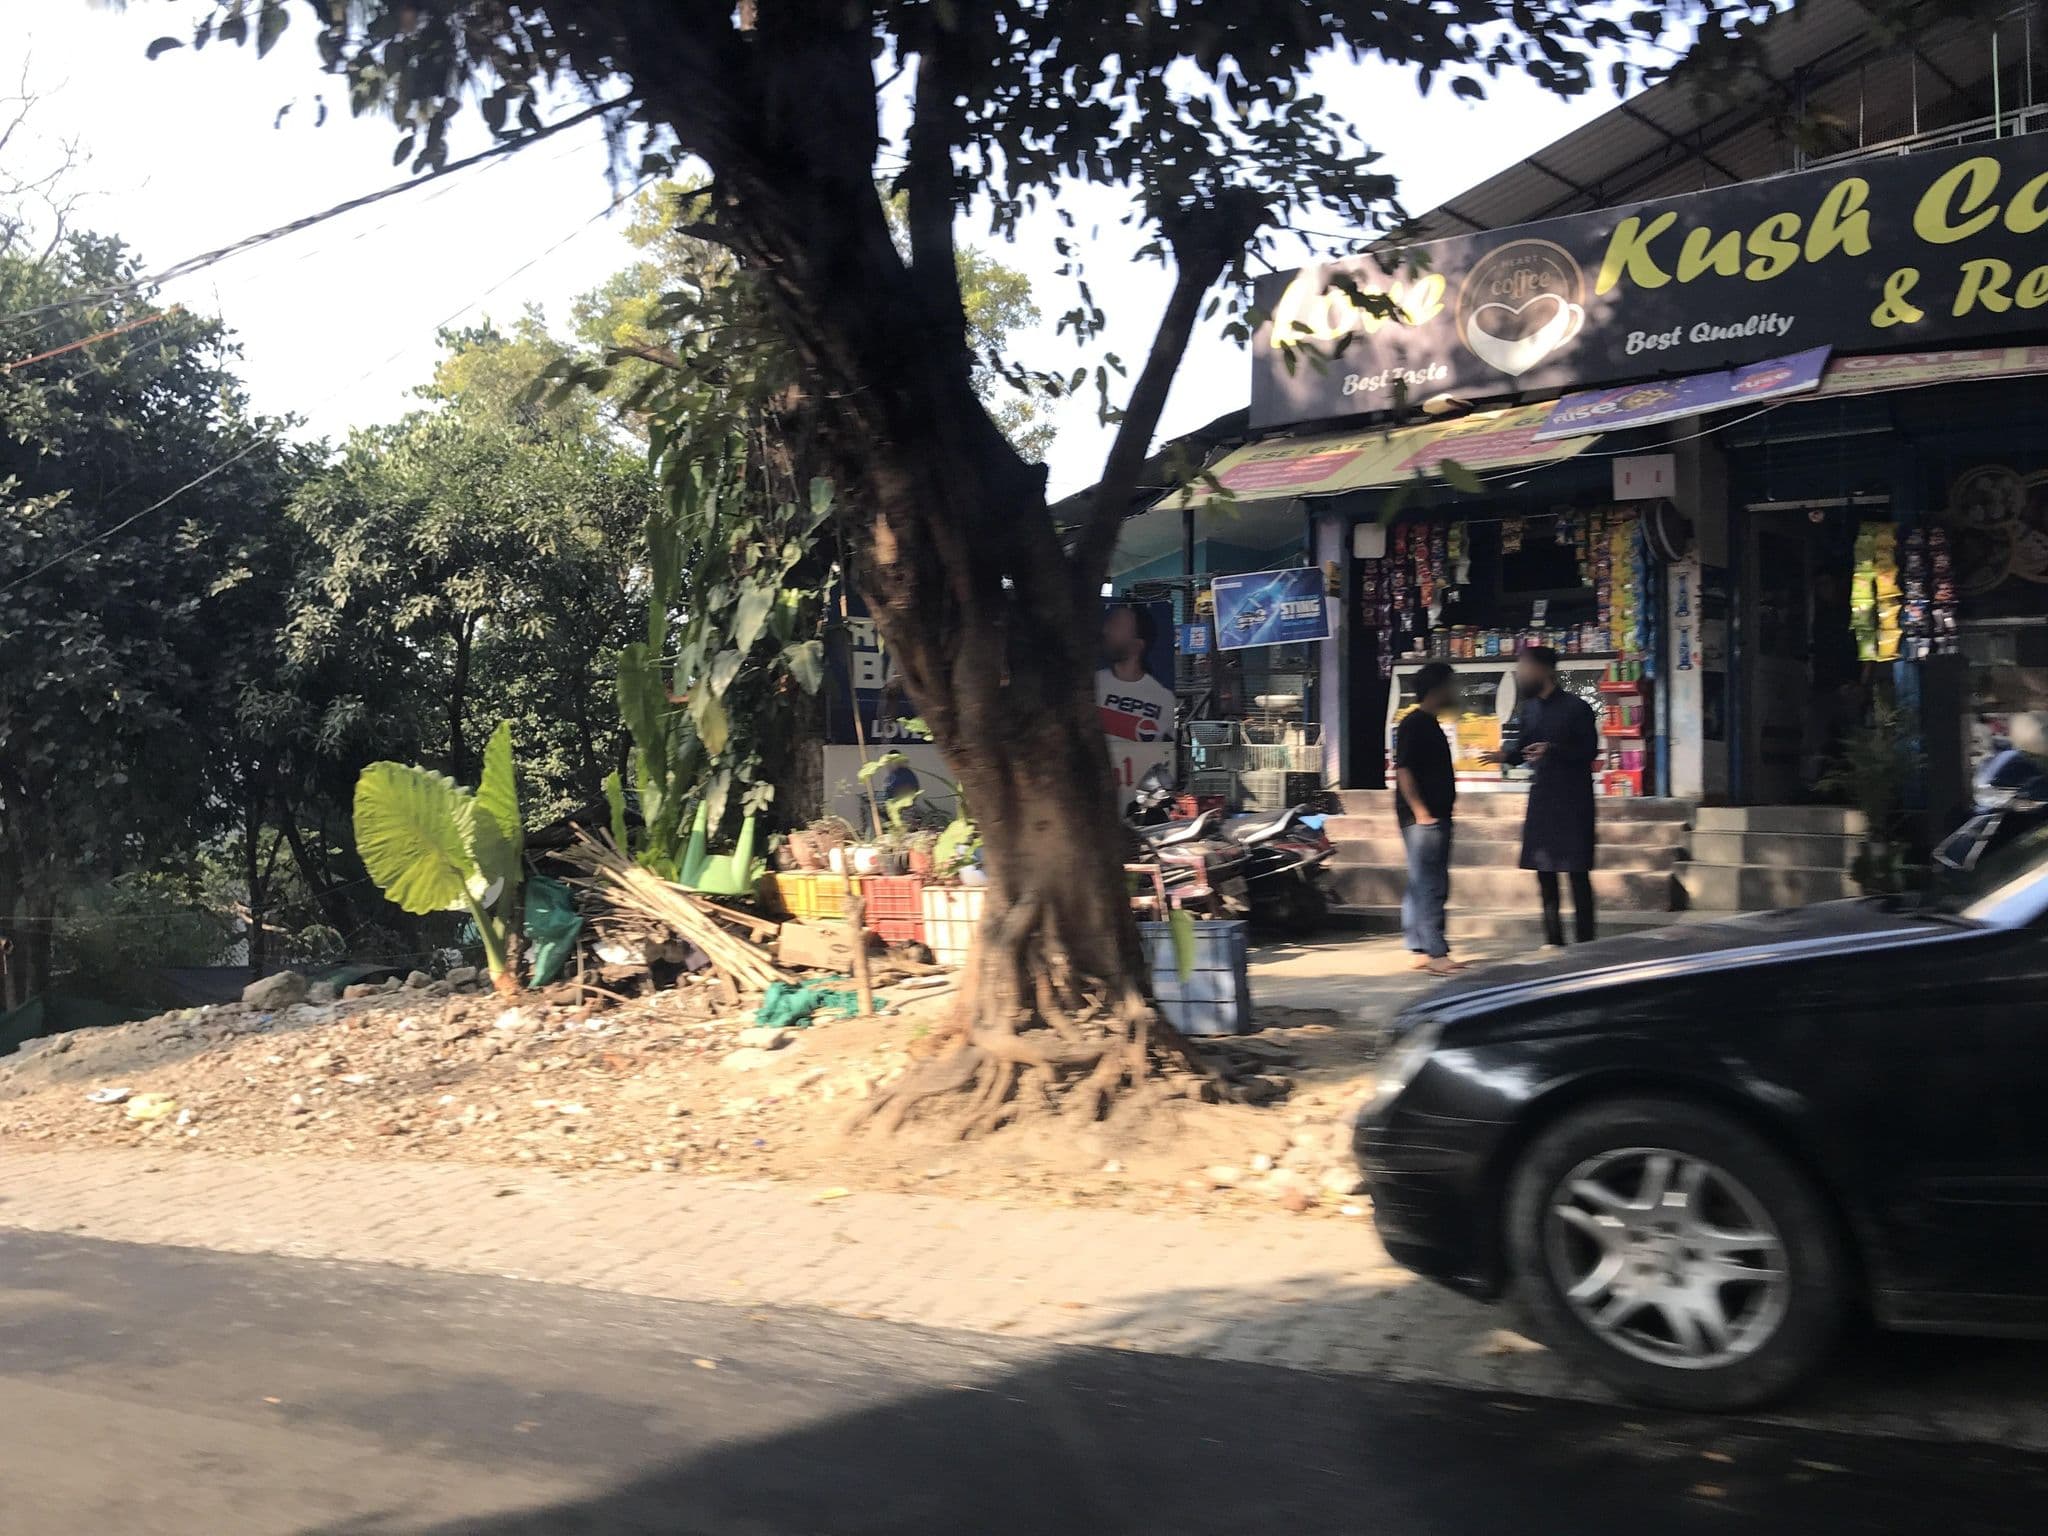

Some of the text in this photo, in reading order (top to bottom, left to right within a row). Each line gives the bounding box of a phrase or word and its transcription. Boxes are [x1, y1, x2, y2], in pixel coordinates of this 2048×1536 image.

[1595, 177, 1872, 296] Kush
[1490, 269, 1551, 299] coffee
[1871, 267, 1925, 328] &
[1625, 313, 1795, 356] Best Quality
[1342, 362, 1448, 396] Best Taste
[1104, 693, 1162, 721] PEPSI
